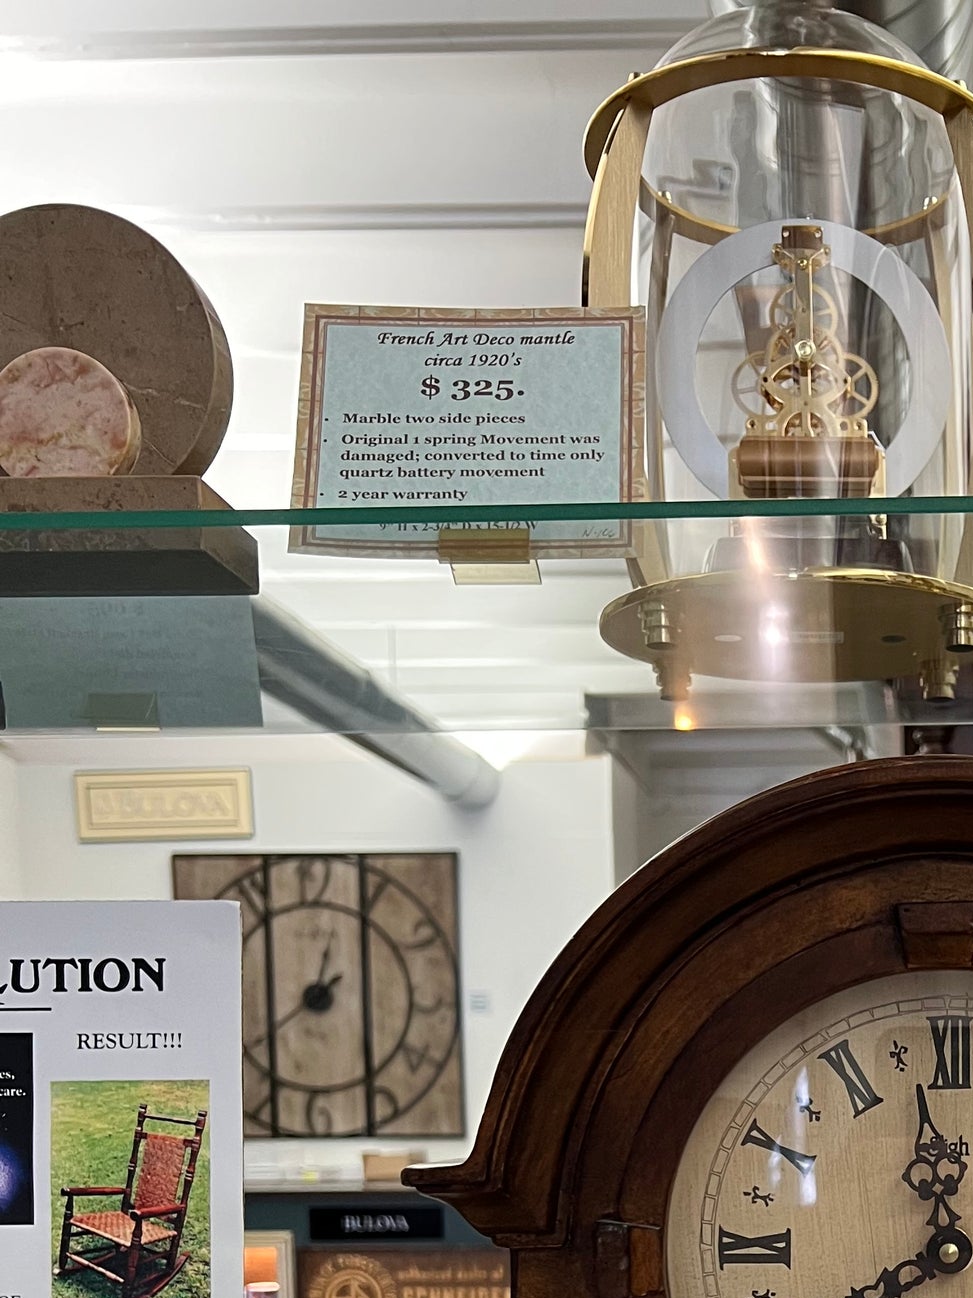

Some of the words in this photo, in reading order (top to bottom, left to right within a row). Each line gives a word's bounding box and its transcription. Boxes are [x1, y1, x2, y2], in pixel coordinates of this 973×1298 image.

[377, 330, 435, 346] French
[437, 332, 468, 347] Art
[473, 332, 515, 346] Deco
[519, 330, 576, 346] mantle
[424, 354, 463, 367] circa
[469, 352, 522, 367] 1920's
[420, 374, 441, 400] $
[451, 379, 525, 401] 325.
[342, 412, 401, 424] Marble
[405, 413, 435, 424] two
[439, 412, 471, 424] side
[476, 412, 526, 426] pieces
[341, 433, 408, 447] Original
[412, 435, 419, 445] 1
[424, 433, 477, 448] spring
[480, 433, 567, 445] Movement
[570, 435, 600, 444] was
[340, 450, 420, 463] damaged;
[424, 449, 505, 461] converted
[510, 450, 526, 461] to
[530, 449, 566, 460] time
[570, 448, 605, 463] only
[339, 467, 394, 480] quartz
[398, 466, 456, 480] battery
[460, 466, 545, 478] movement
[338, 490, 348, 499] 2
[352, 489, 389, 502] year
[393, 488, 468, 502] warranty
[0, 958, 166, 994] UTION
[77, 1032, 183, 1050] RESULT!!!
